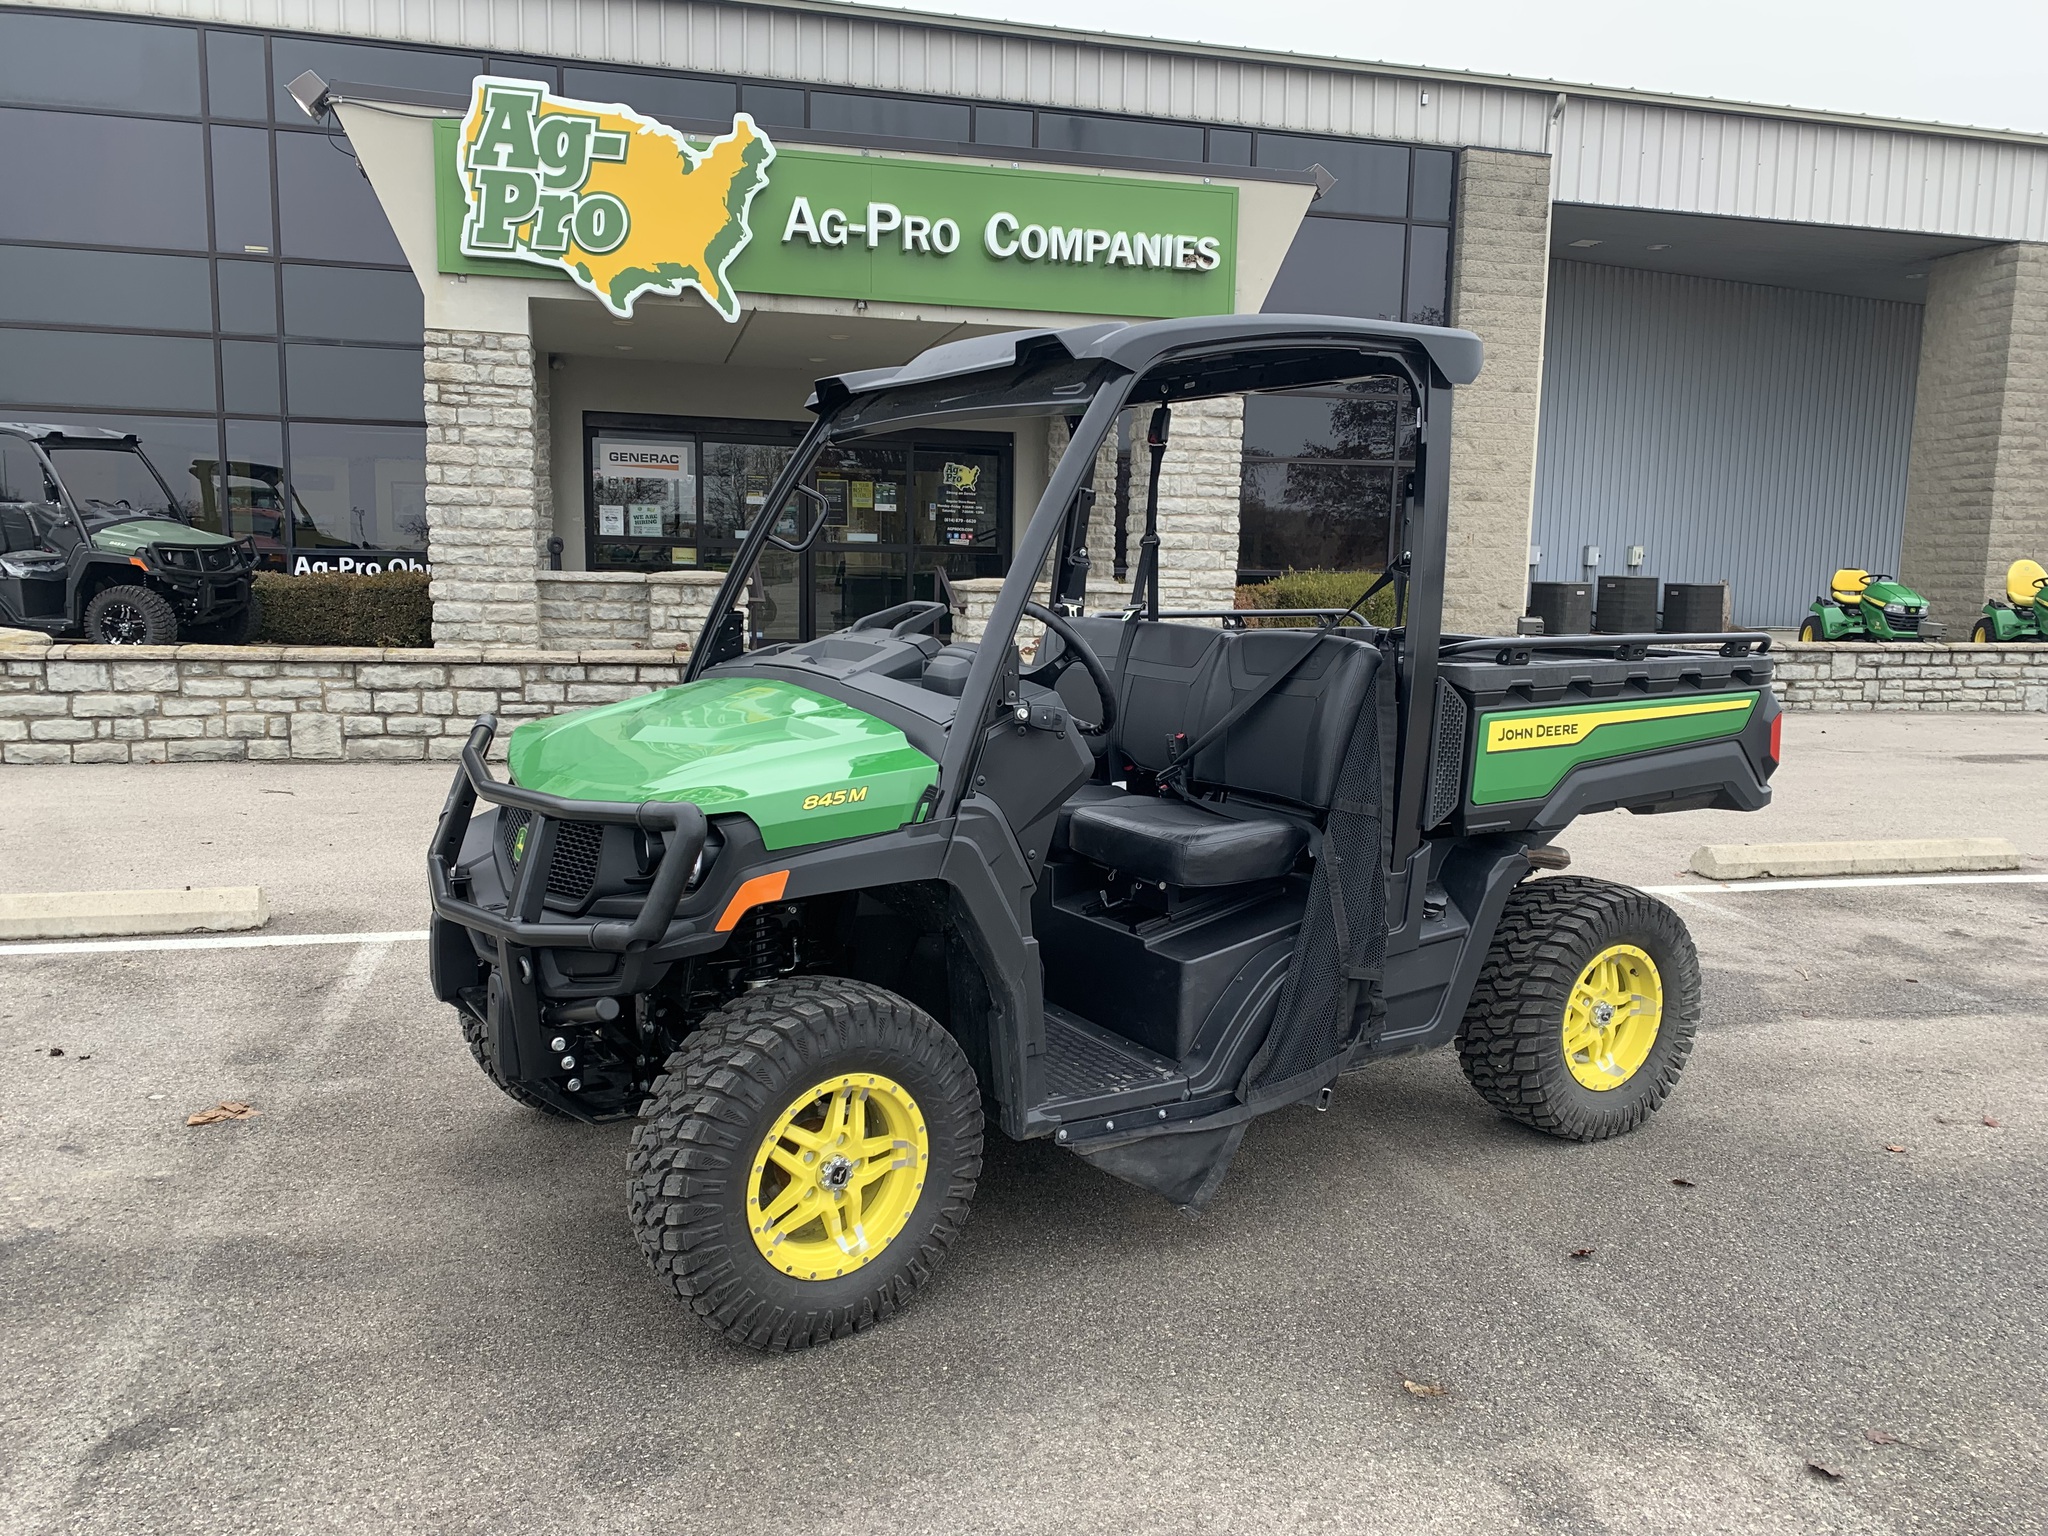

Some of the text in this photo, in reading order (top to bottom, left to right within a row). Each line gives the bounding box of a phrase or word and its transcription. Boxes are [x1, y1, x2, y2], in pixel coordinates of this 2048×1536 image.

[466, 86, 629, 191] Ag-
[469, 169, 629, 254] Pro
[609, 452, 680, 464] GENERAC
[946, 474, 963, 482] Pro
[1498, 725, 1578, 741] JOHN DEERE
